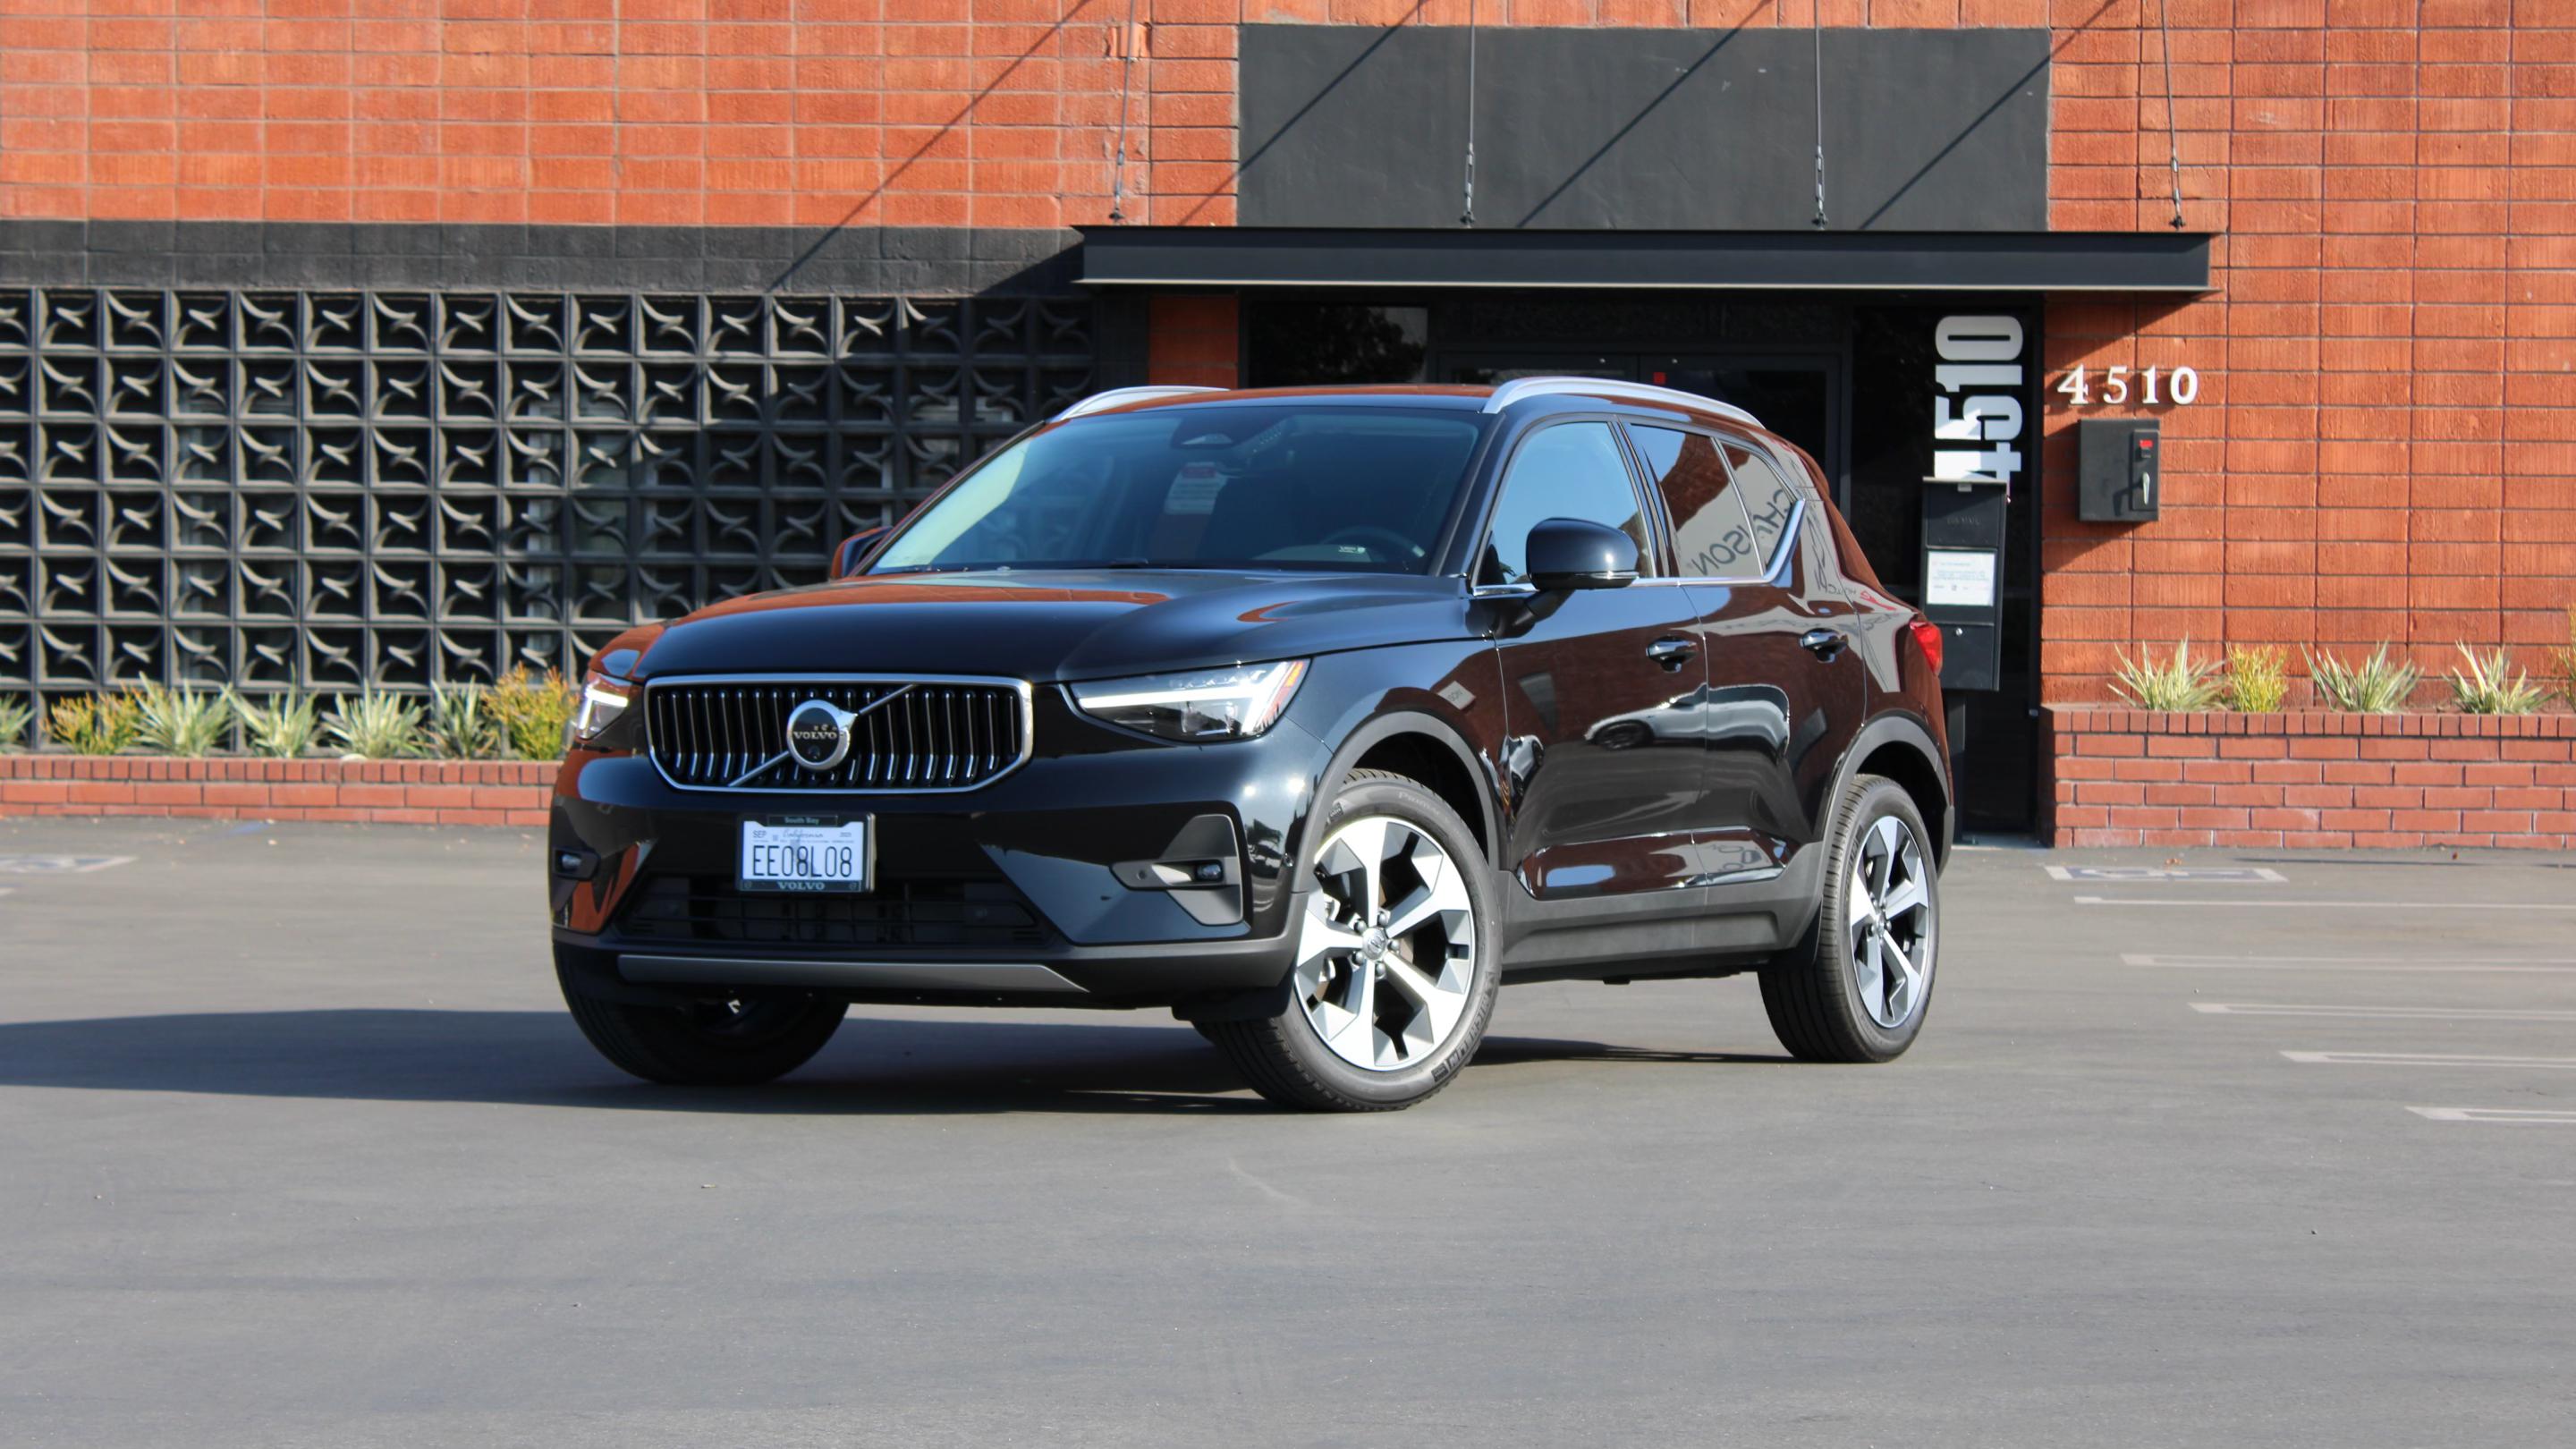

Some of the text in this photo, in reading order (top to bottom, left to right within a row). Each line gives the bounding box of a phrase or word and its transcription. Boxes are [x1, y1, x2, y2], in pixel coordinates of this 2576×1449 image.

[2057, 364, 2198, 404] 4510
[1934, 316, 2023, 479] 4510
[792, 731, 837, 740] VOLVO
[752, 830, 767, 838] SEP
[783, 828, 824, 839] California
[753, 845, 852, 877] EE08L08
[777, 881, 825, 890] VOLVO
